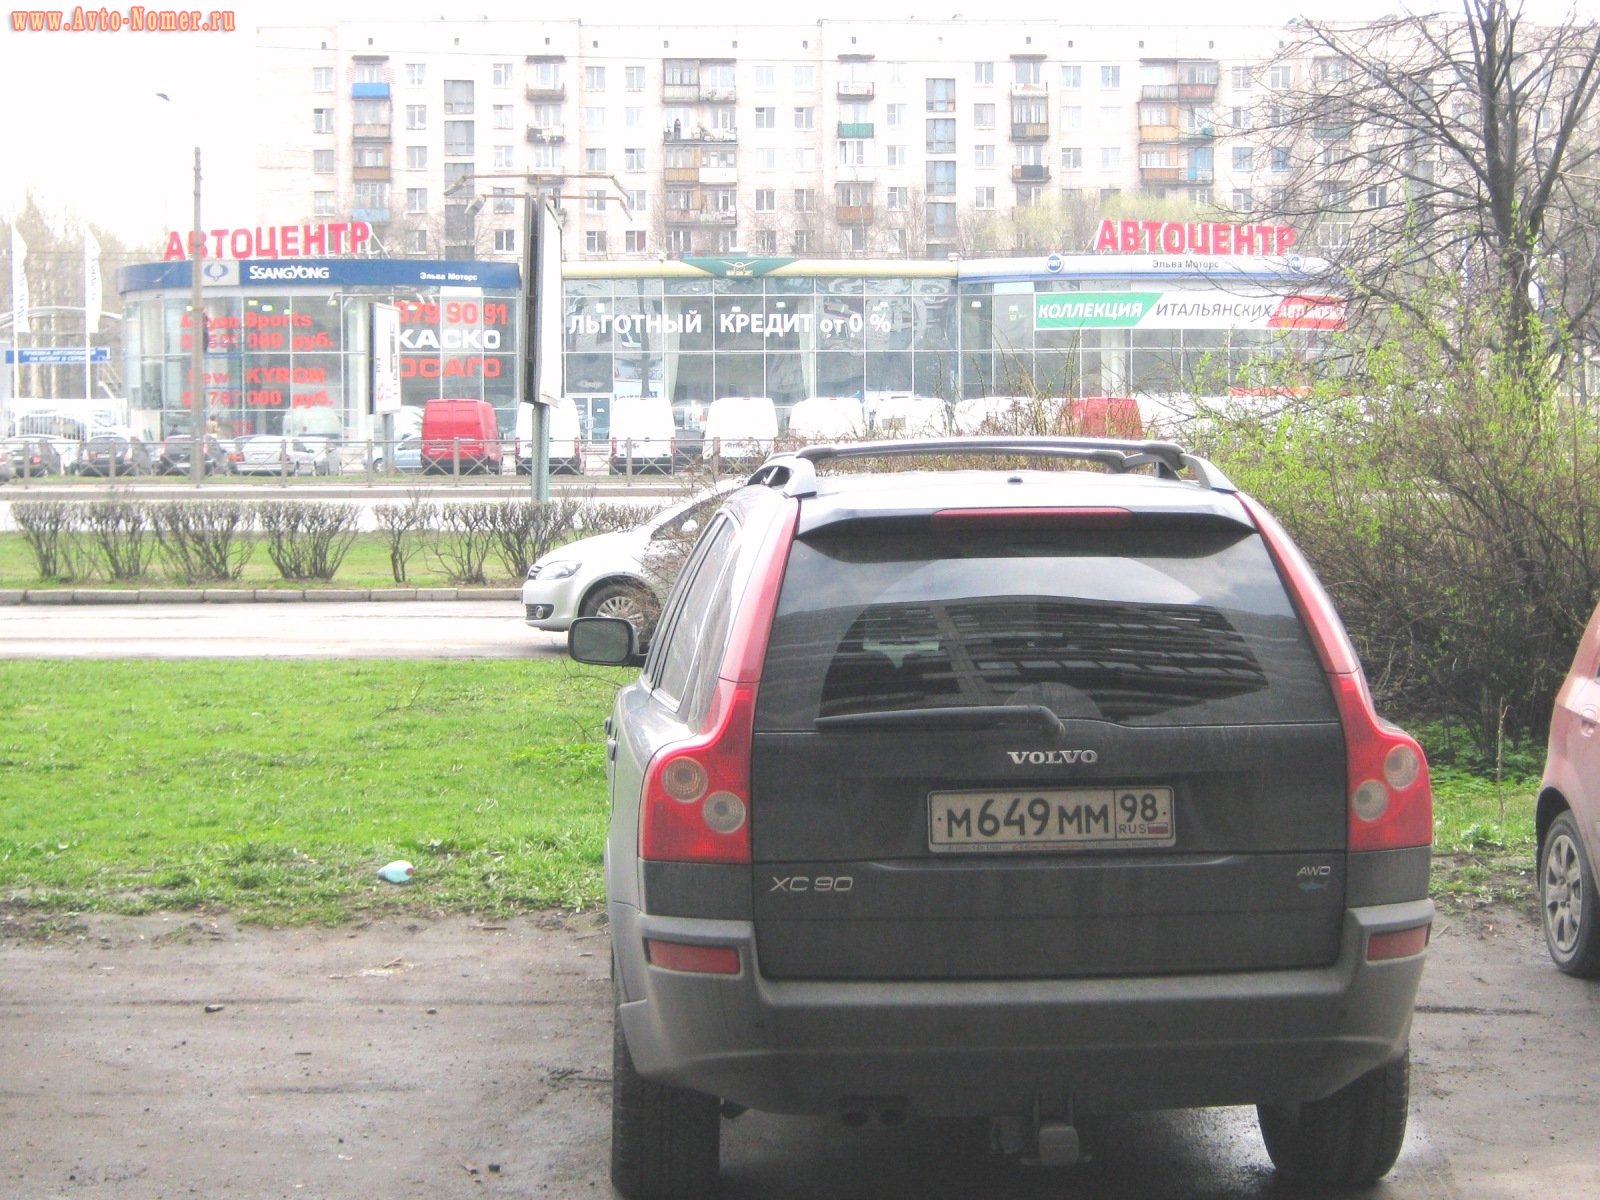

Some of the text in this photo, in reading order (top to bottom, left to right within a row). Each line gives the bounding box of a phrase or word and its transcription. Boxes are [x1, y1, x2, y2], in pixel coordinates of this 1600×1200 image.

[164, 221, 370, 261] АВТОЦЕНТР
[1098, 219, 1296, 256] АВТОЦЕНТР
[446, 301, 478, 325] 90
[1038, 300, 1143, 320] КОЛЛЕКЦИЯ
[1155, 303, 1272, 318] ИТАЛЬЯНСКИХ
[569, 310, 702, 336] ЛЬГОТНЫЙ
[720, 313, 814, 338] КРЕДИТ
[820, 319, 846, 333] от
[870, 314, 891, 333] %
[400, 329, 501, 349] КАСКО
[245, 367, 327, 385] KYRON
[400, 356, 502, 379] ОСАГО
[1007, 749, 1098, 765] VOLVO
[1118, 793, 1158, 823] 98
[1118, 823, 1147, 835] RUS
[1296, 865, 1332, 877] AWD
